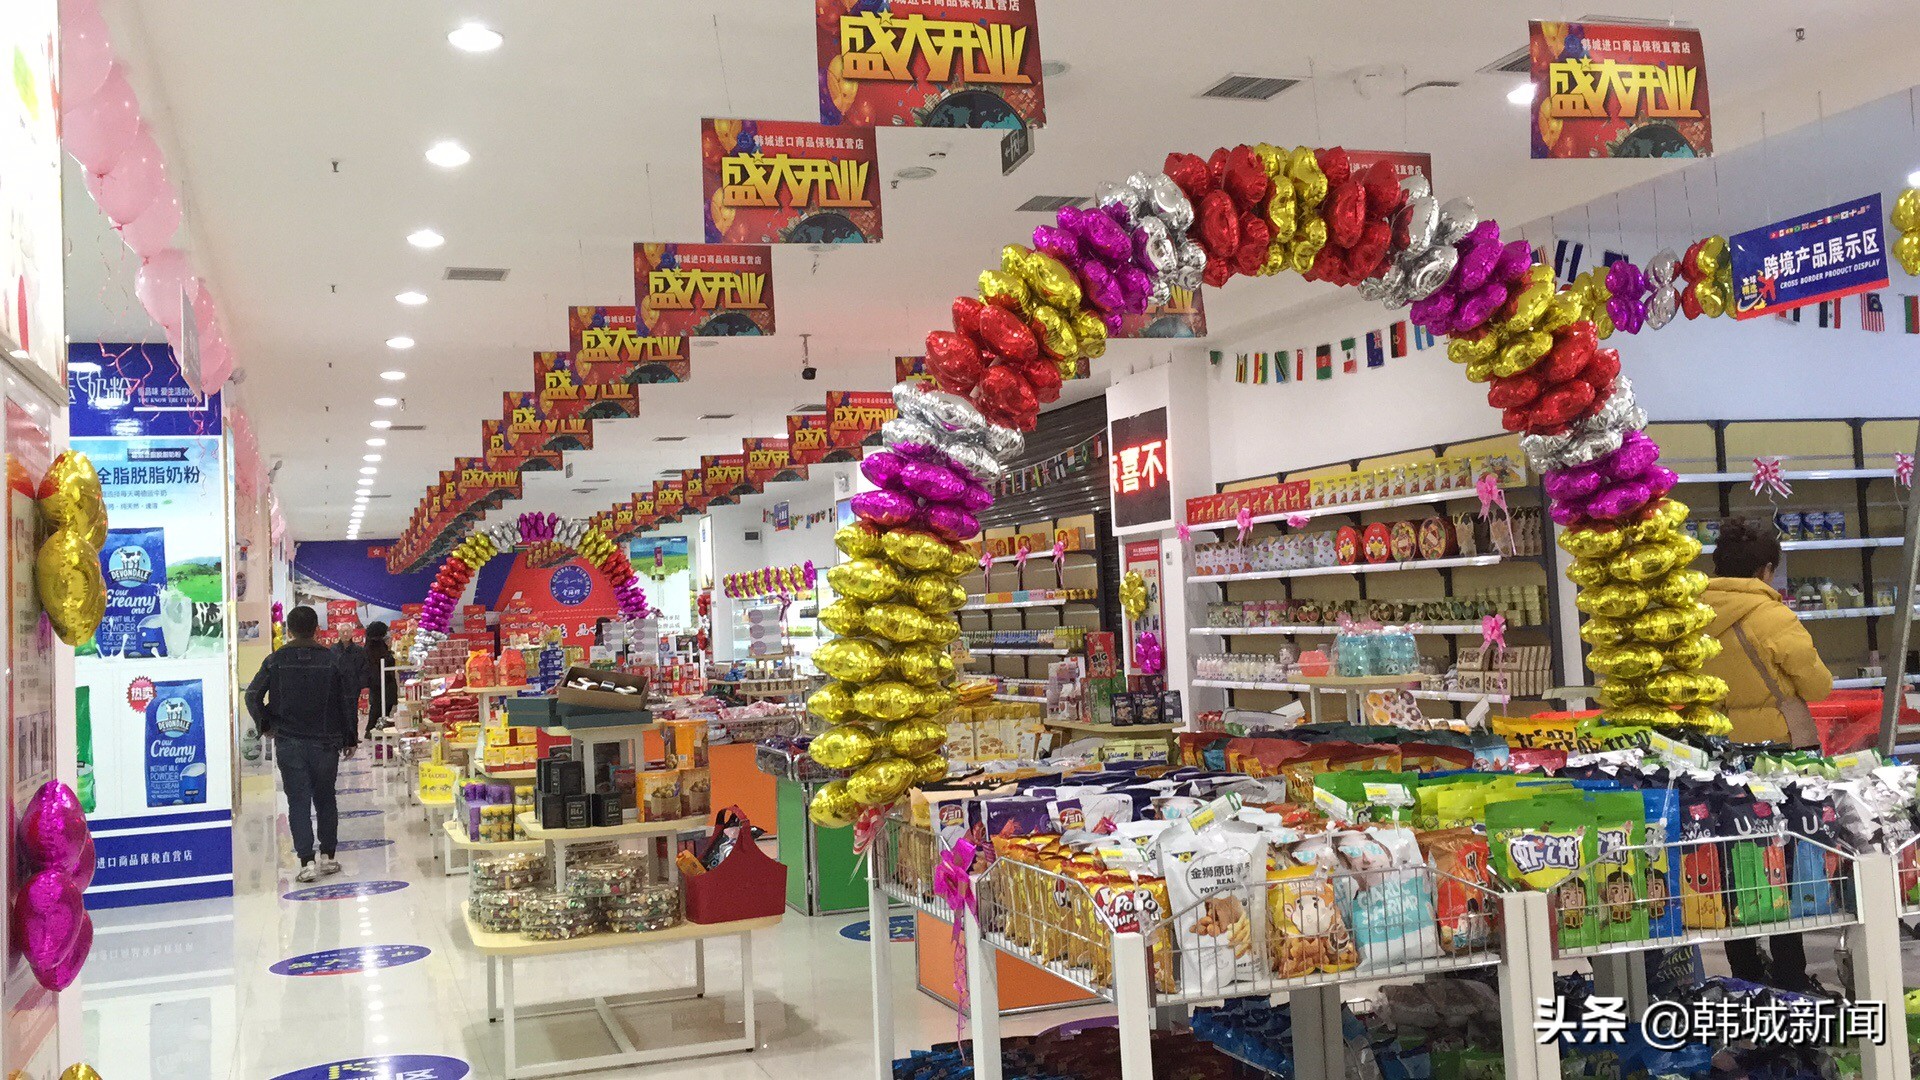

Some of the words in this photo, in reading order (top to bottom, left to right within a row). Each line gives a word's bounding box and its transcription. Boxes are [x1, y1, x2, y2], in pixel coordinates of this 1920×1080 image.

[840, 10, 1032, 84] 盛大开业
[1550, 58, 1702, 118] 盛大开业
[721, 153, 873, 208] 盛大开业
[1764, 228, 1880, 279] 跨境产品展示区
[649, 268, 768, 310] 盛大开业
[98, 465, 200, 486] 全脂脱脂奶粉
[131, 688, 153, 700] 热卖
[151, 740, 196, 763] Creamy
[1216, 877, 1235, 885] REAL
